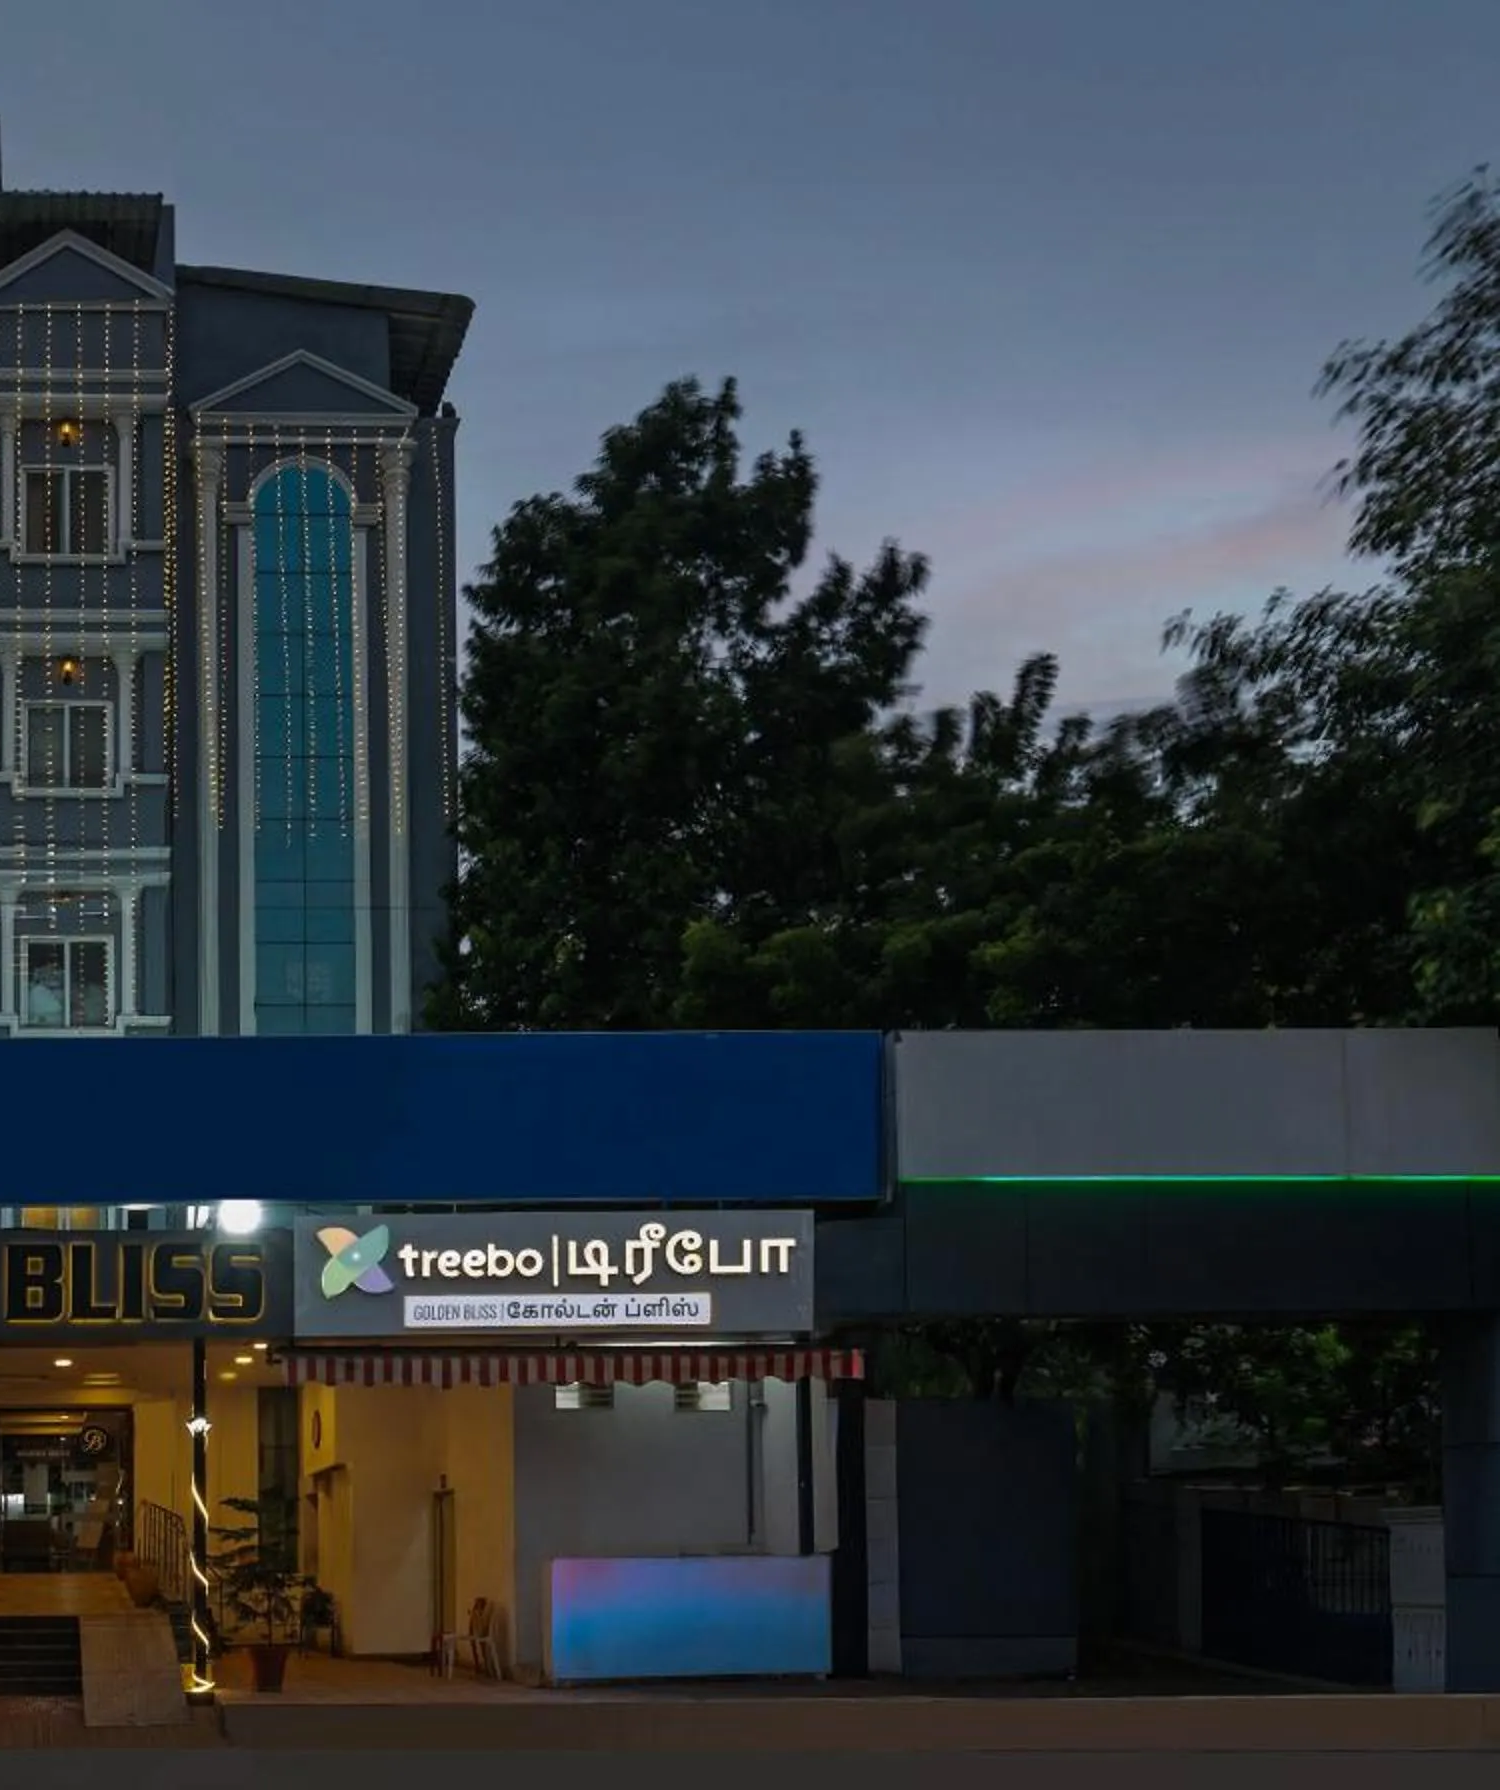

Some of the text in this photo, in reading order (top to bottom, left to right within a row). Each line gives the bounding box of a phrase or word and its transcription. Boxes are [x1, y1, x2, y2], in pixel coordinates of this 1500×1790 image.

[398, 1243, 544, 1278] treebo
[567, 1222, 797, 1286] டிரீபோ
[5, 1241, 266, 1324] BLISS
[413, 1304, 498, 1321] GOLDEN BLISS
[506, 1297, 700, 1319] கோல்டன் ப்ளிஸ்
